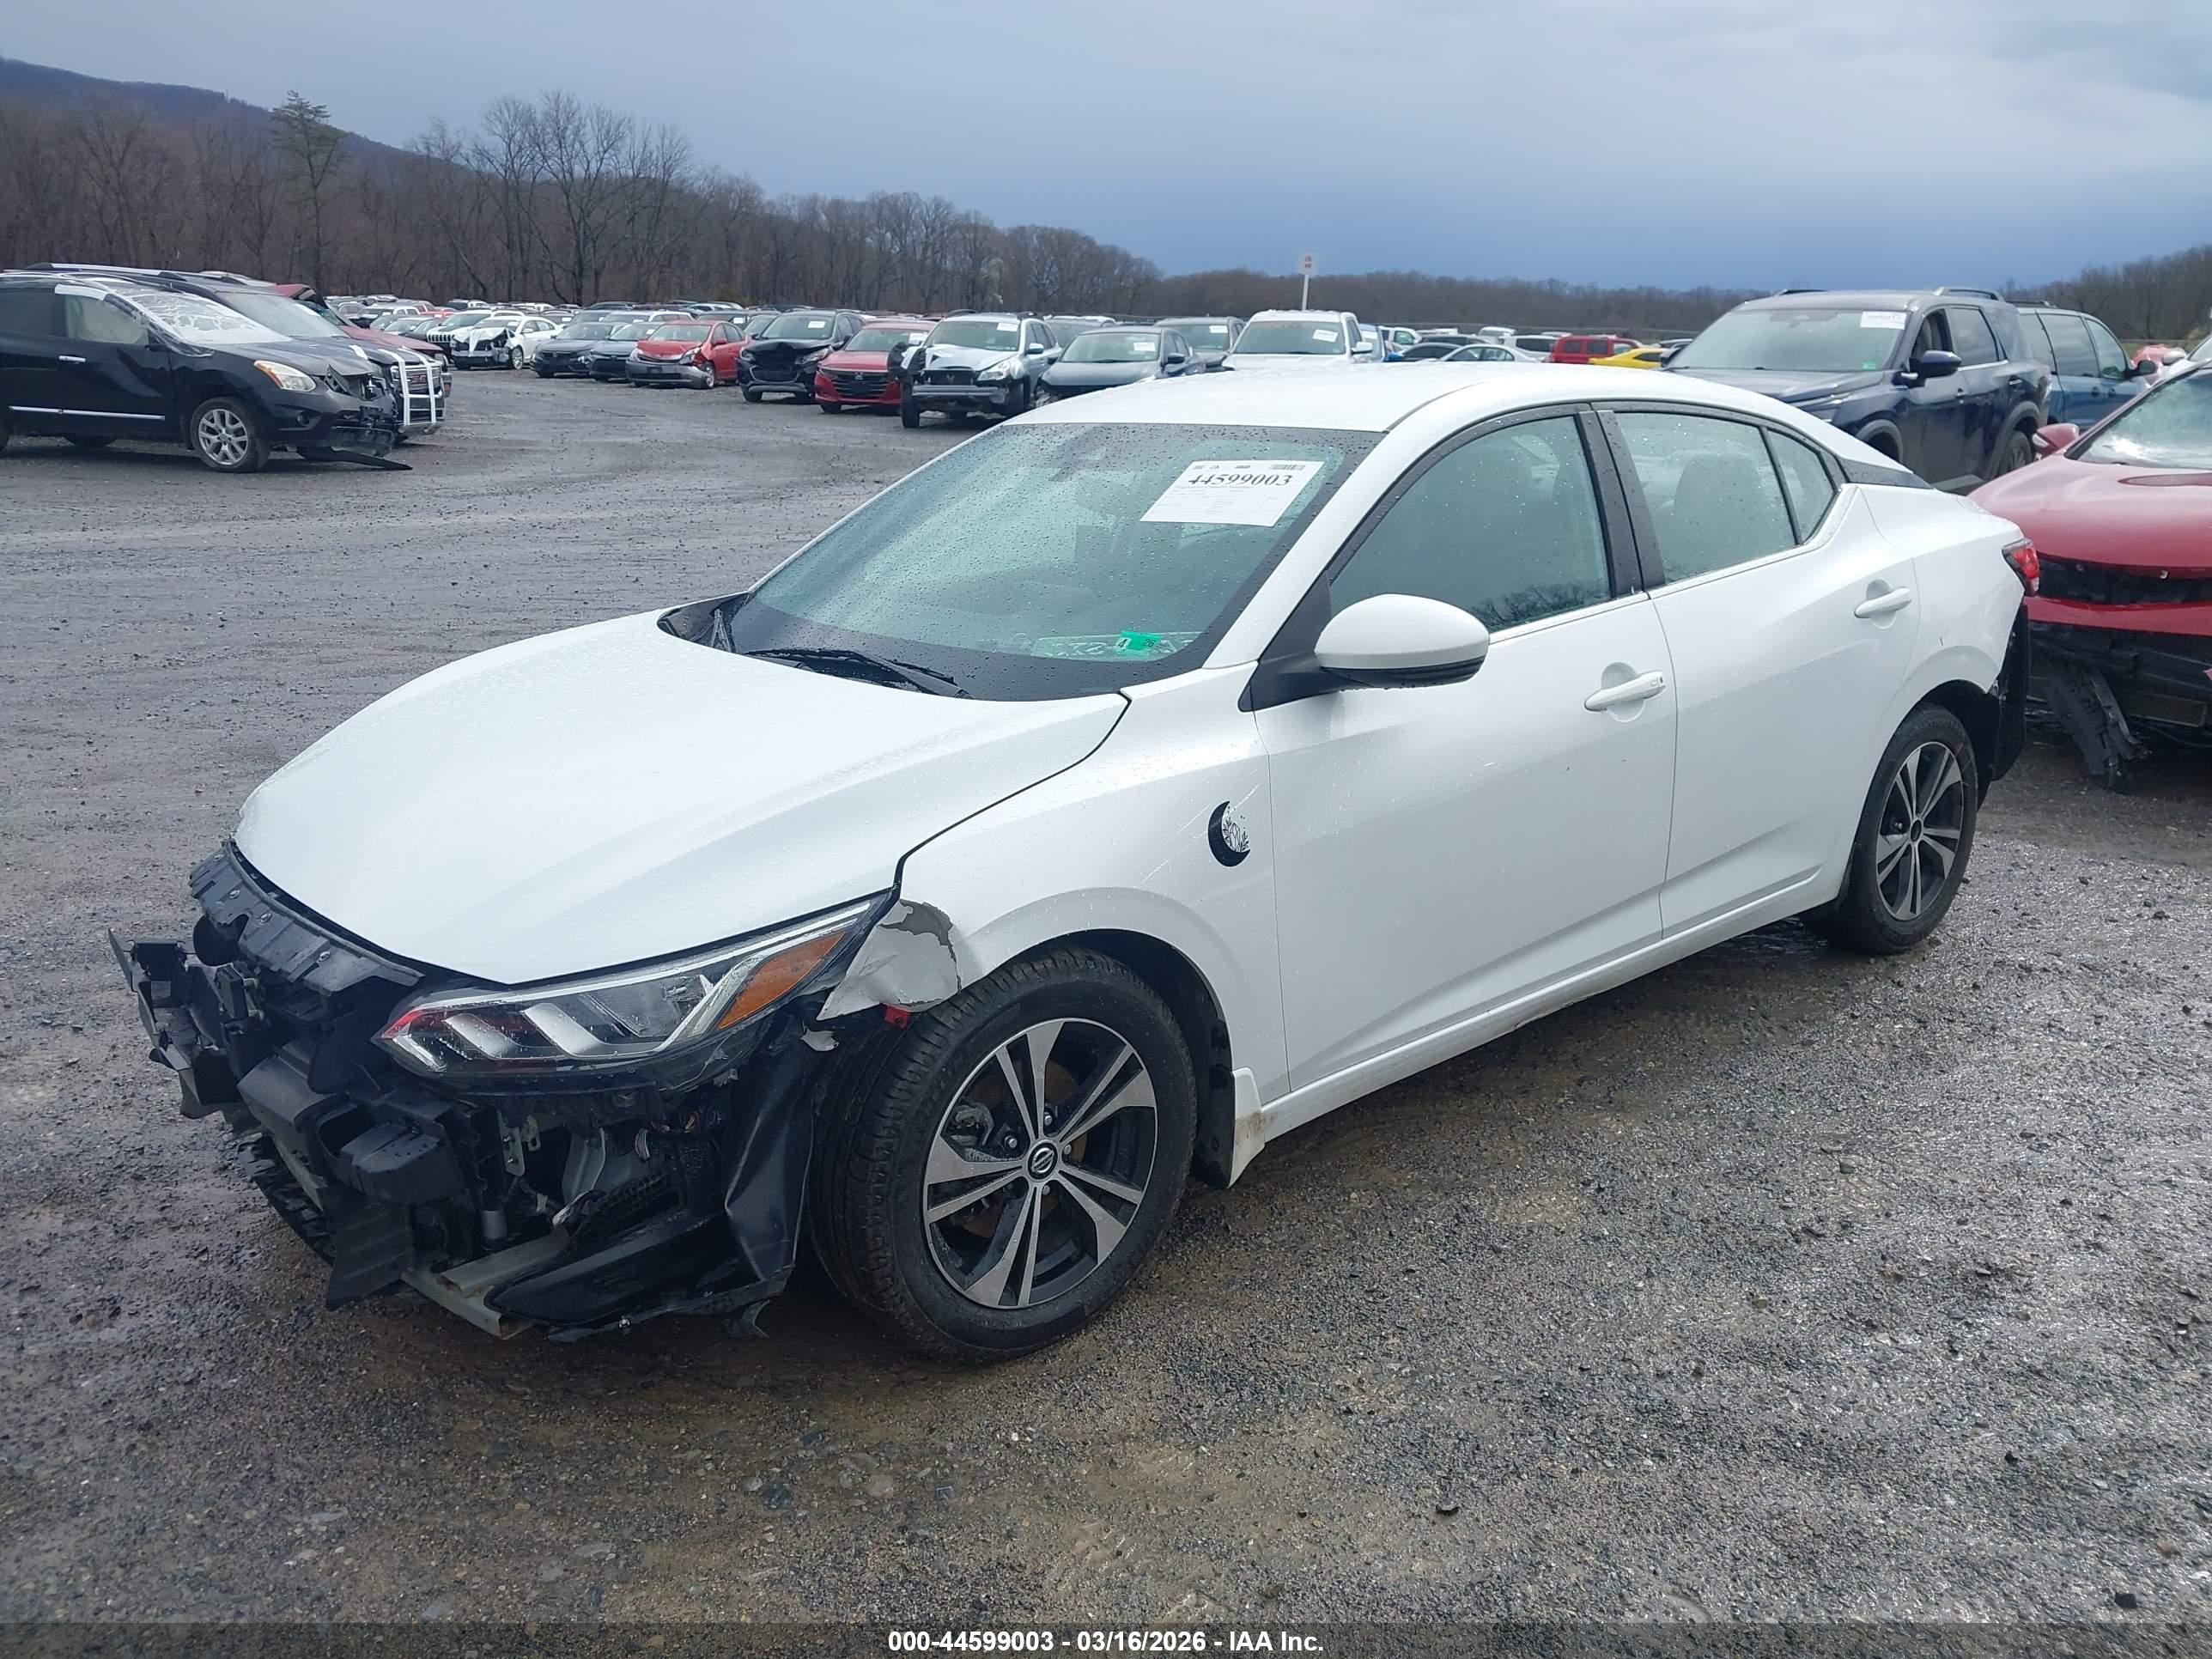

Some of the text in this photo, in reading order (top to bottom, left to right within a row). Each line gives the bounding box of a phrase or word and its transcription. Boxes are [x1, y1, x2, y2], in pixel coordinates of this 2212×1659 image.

[1188, 473, 1293, 486] 44599003
[1117, 638, 1127, 648] 4
[1143, 638, 1156, 647] 26
